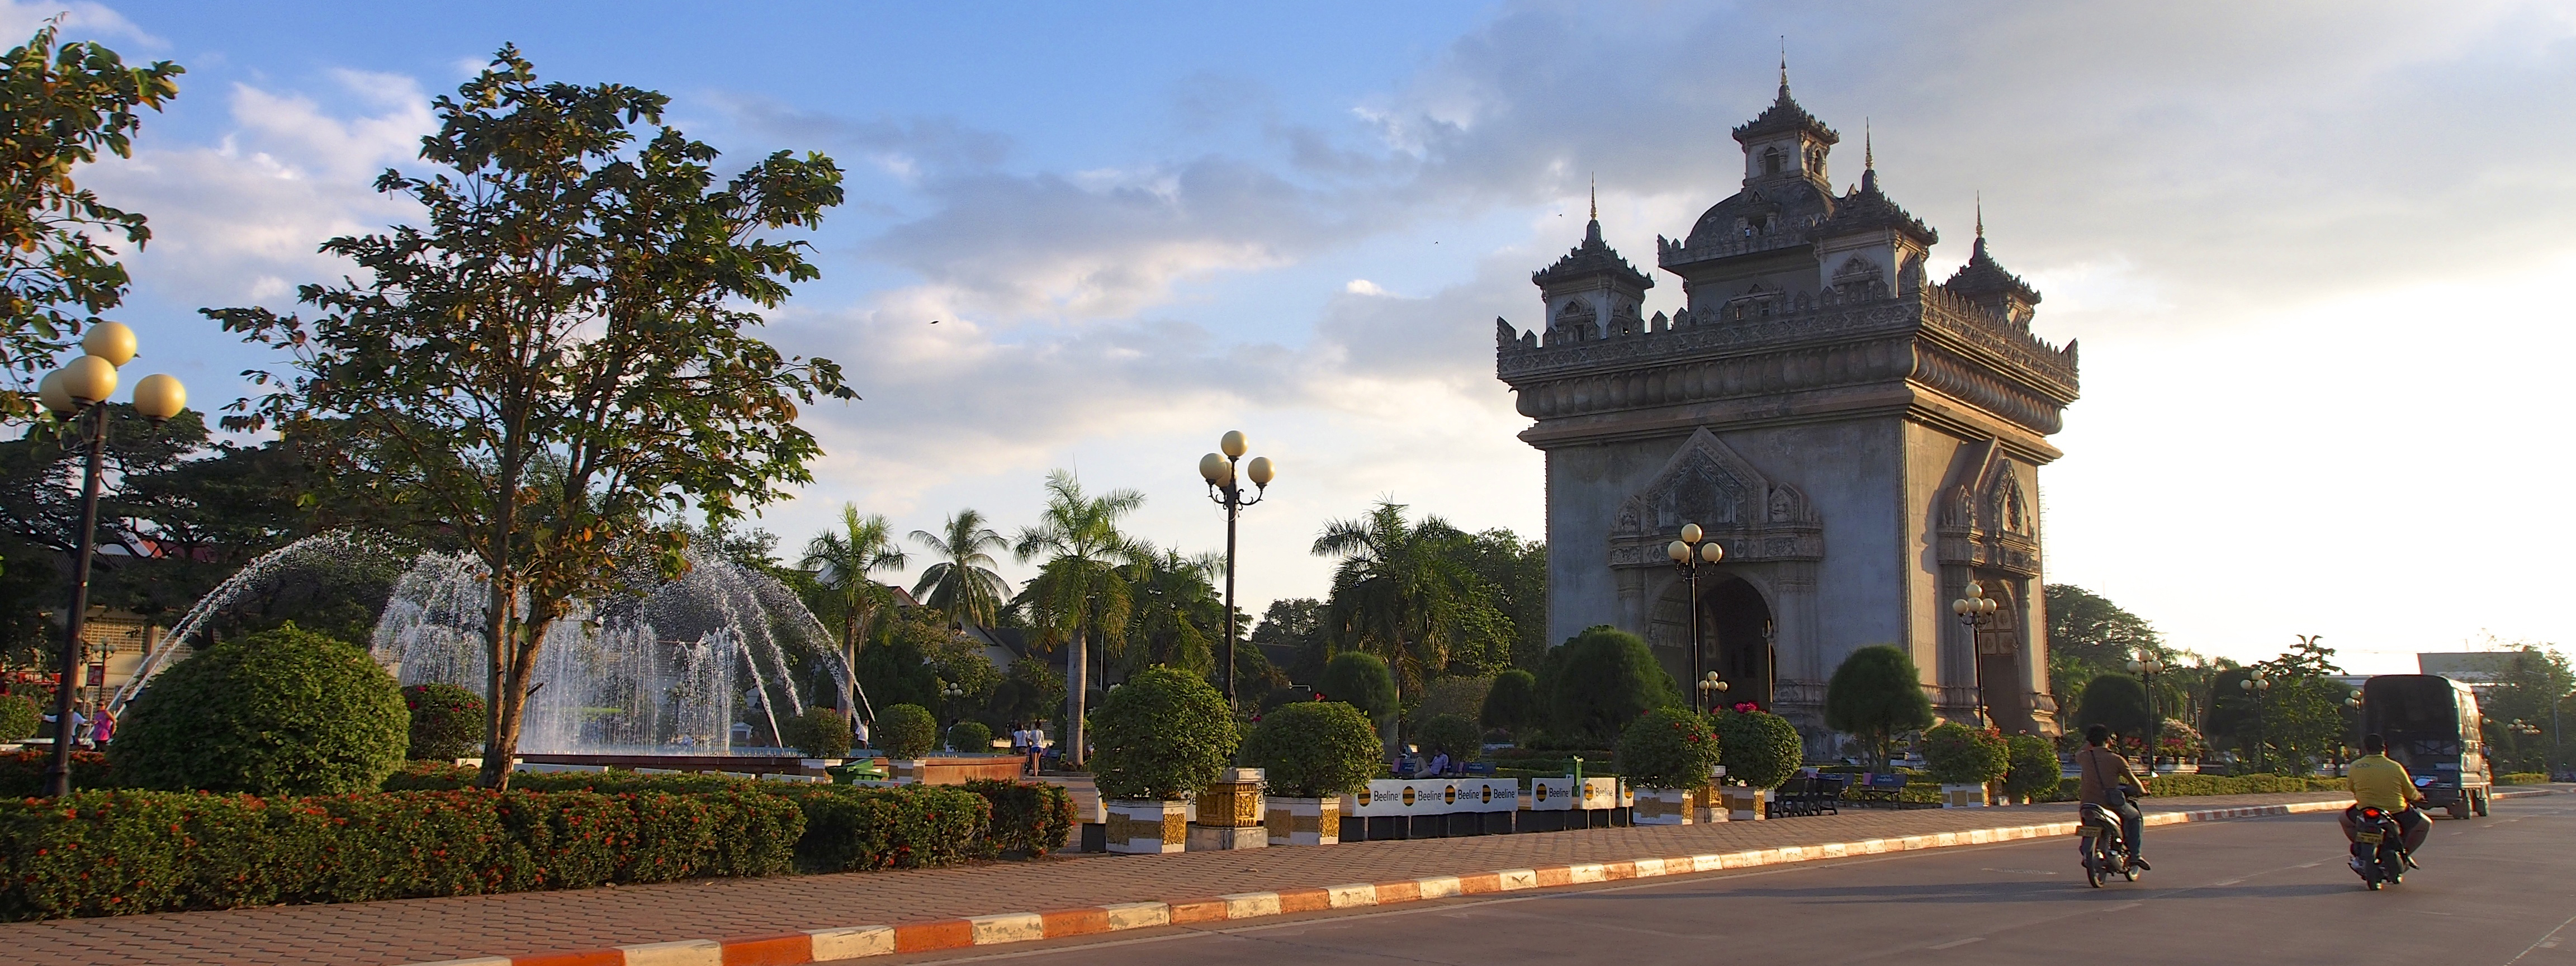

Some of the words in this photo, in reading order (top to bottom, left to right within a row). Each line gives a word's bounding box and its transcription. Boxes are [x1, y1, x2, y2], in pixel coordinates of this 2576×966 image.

[1374, 790, 1399, 801] Beeline
[1418, 790, 1441, 801] Beeline
[1458, 789, 1479, 799] Beeline
[1494, 788, 1514, 799] Beeline
[1549, 788, 1569, 797] Beeline
